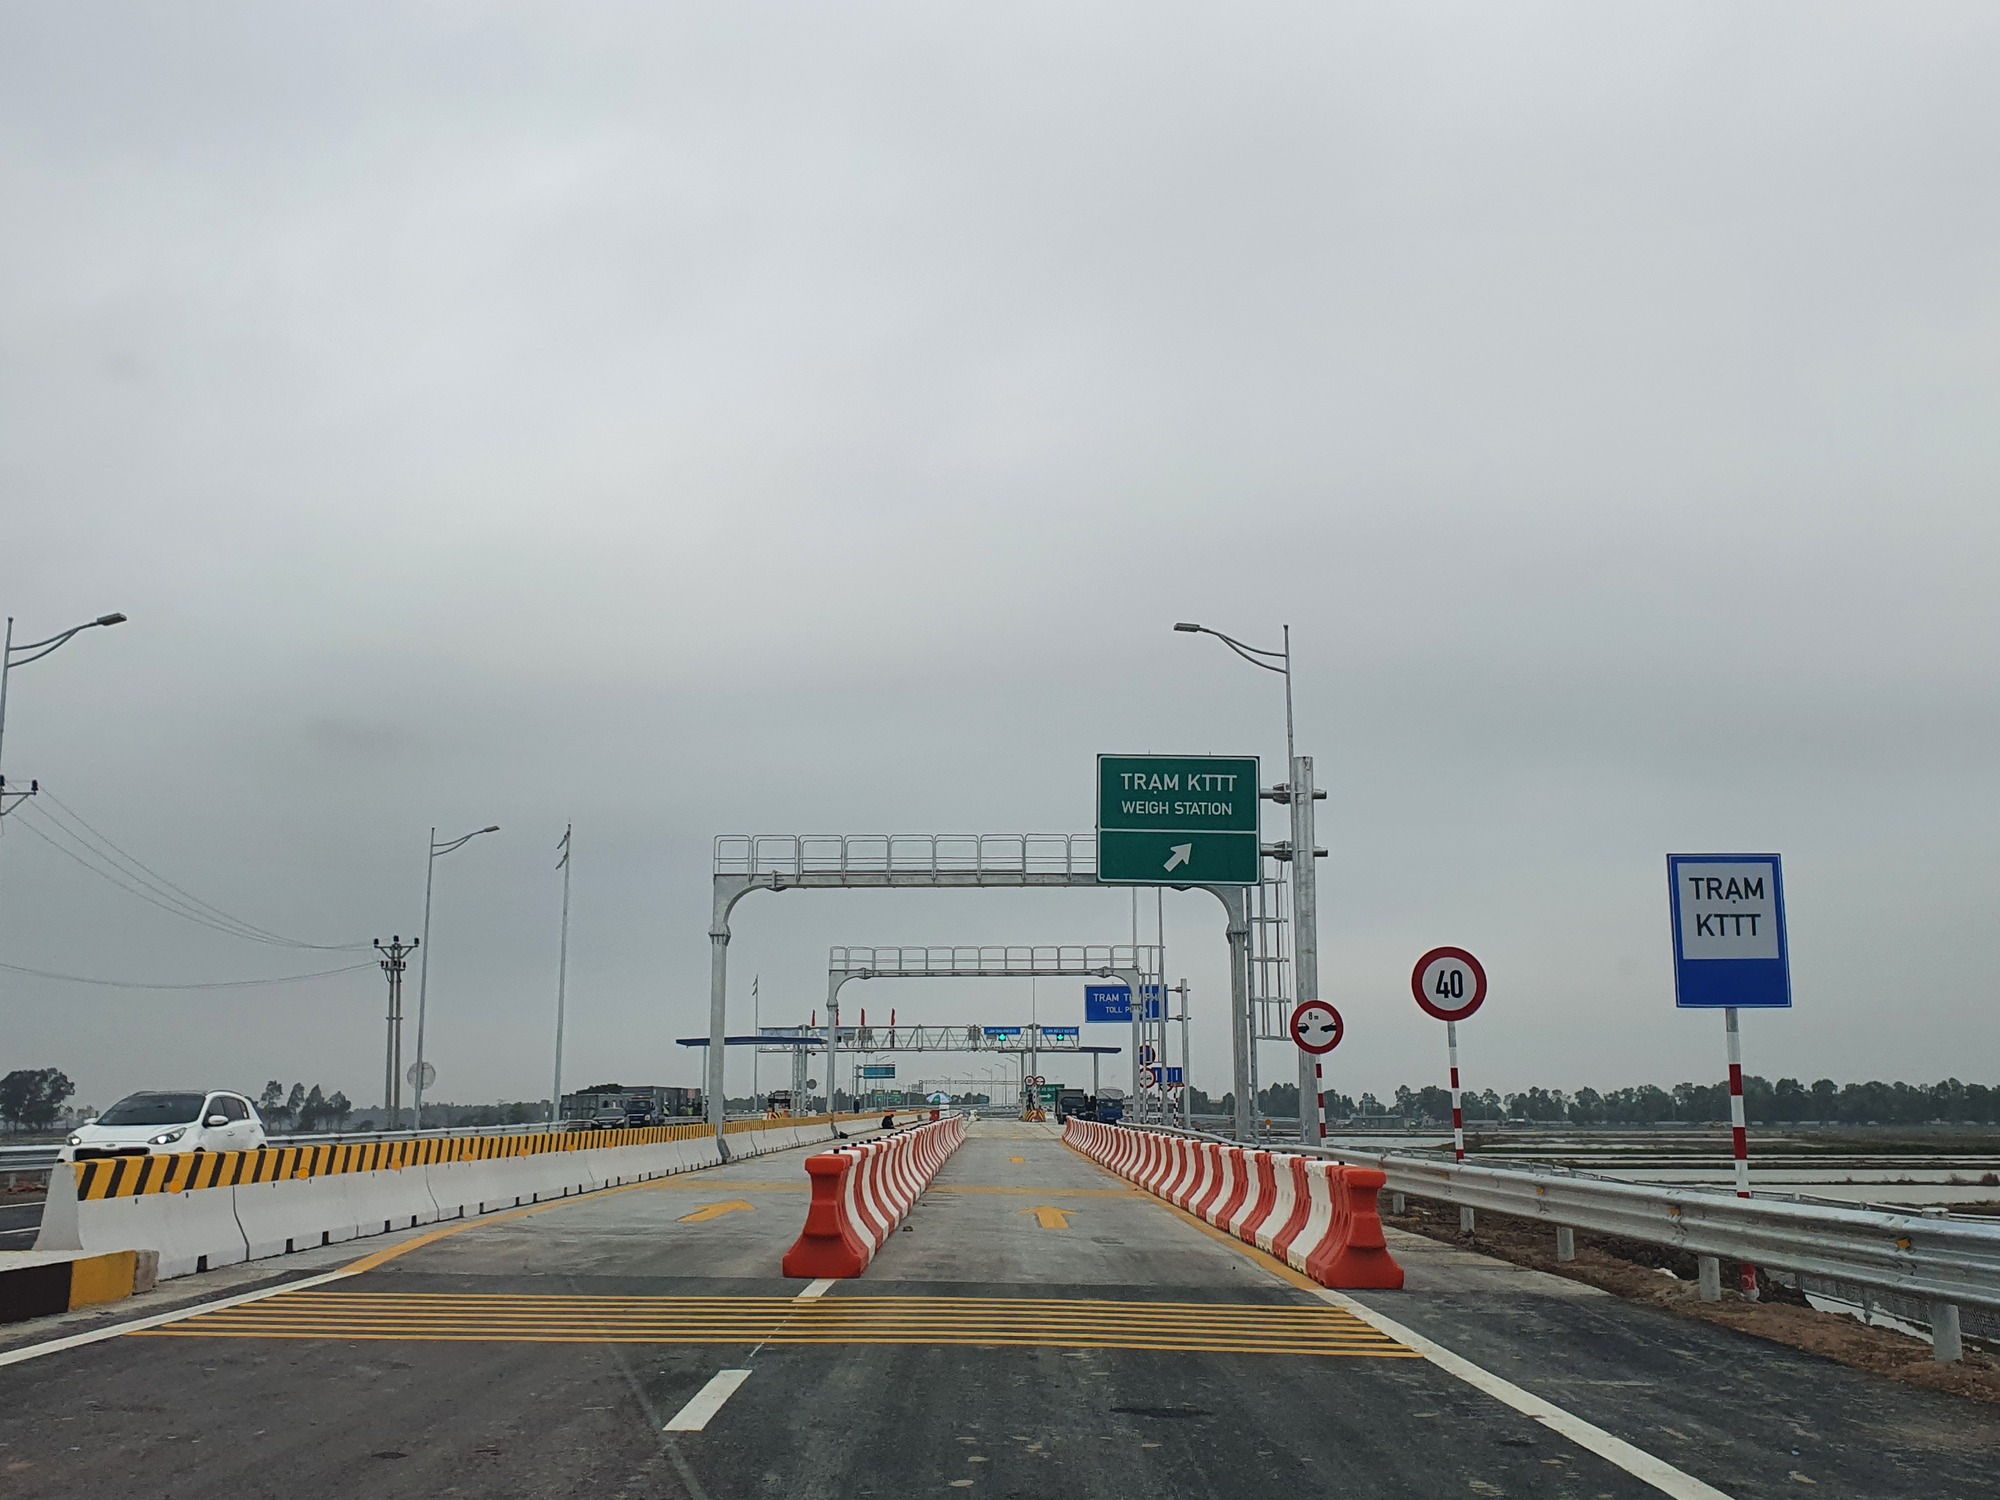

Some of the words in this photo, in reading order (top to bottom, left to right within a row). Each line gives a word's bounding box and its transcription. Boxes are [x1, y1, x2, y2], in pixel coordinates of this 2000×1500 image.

[1120, 773, 1179, 795] TRẠM
[1187, 773, 1238, 792] KTTT
[1121, 800, 1169, 815] WEIGH
[1174, 801, 1232, 816] STATION
[1688, 876, 1765, 904] TRẠM
[1695, 913, 1762, 937] KTTT
[1435, 969, 1464, 999] 40
[1105, 1006, 1123, 1014] TOLL
[1308, 1011, 1313, 1021] 8
